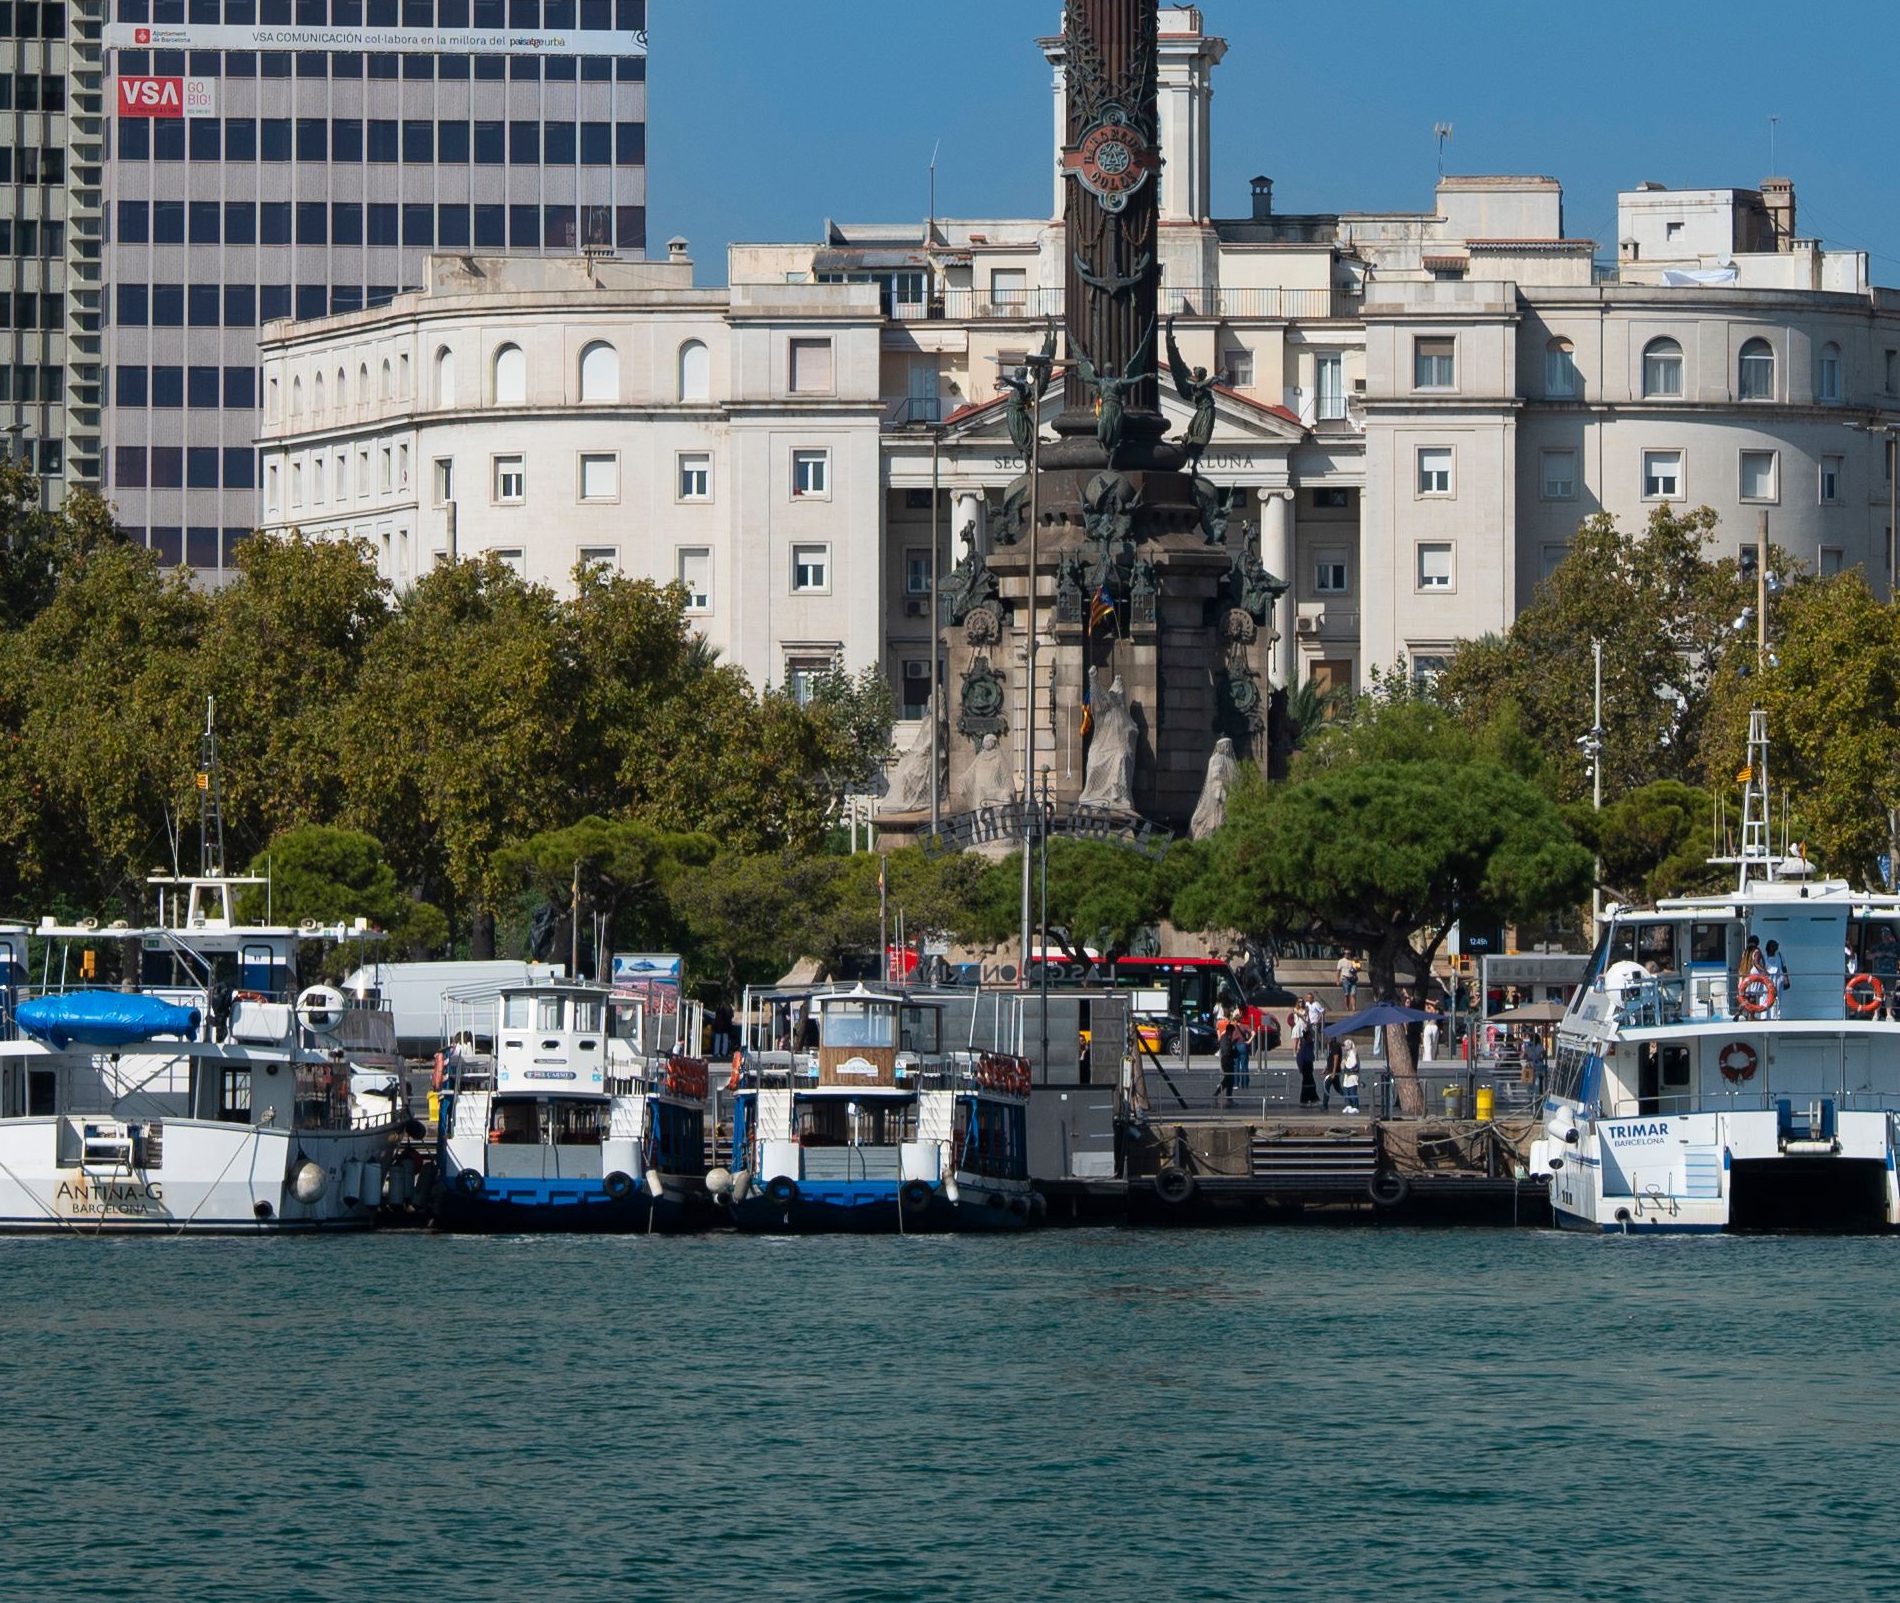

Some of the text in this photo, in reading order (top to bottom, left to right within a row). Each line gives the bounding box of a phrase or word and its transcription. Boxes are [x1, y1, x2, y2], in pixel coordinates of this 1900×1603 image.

[252, 32, 273, 42] VSA
[276, 31, 362, 44] COMUNICACIÓN
[437, 34, 447, 45] la
[449, 34, 486, 45] millora
[489, 35, 506, 45] del
[122, 81, 179, 105] VSA
[188, 82, 204, 93] GO
[188, 95, 211, 105] BIG!
[1608, 1122, 1669, 1139] TRIMAR
[1614, 1137, 1665, 1148] BARCELONA
[57, 1180, 164, 1201] ANTINA-G
[72, 1203, 149, 1214] BARCELONA
